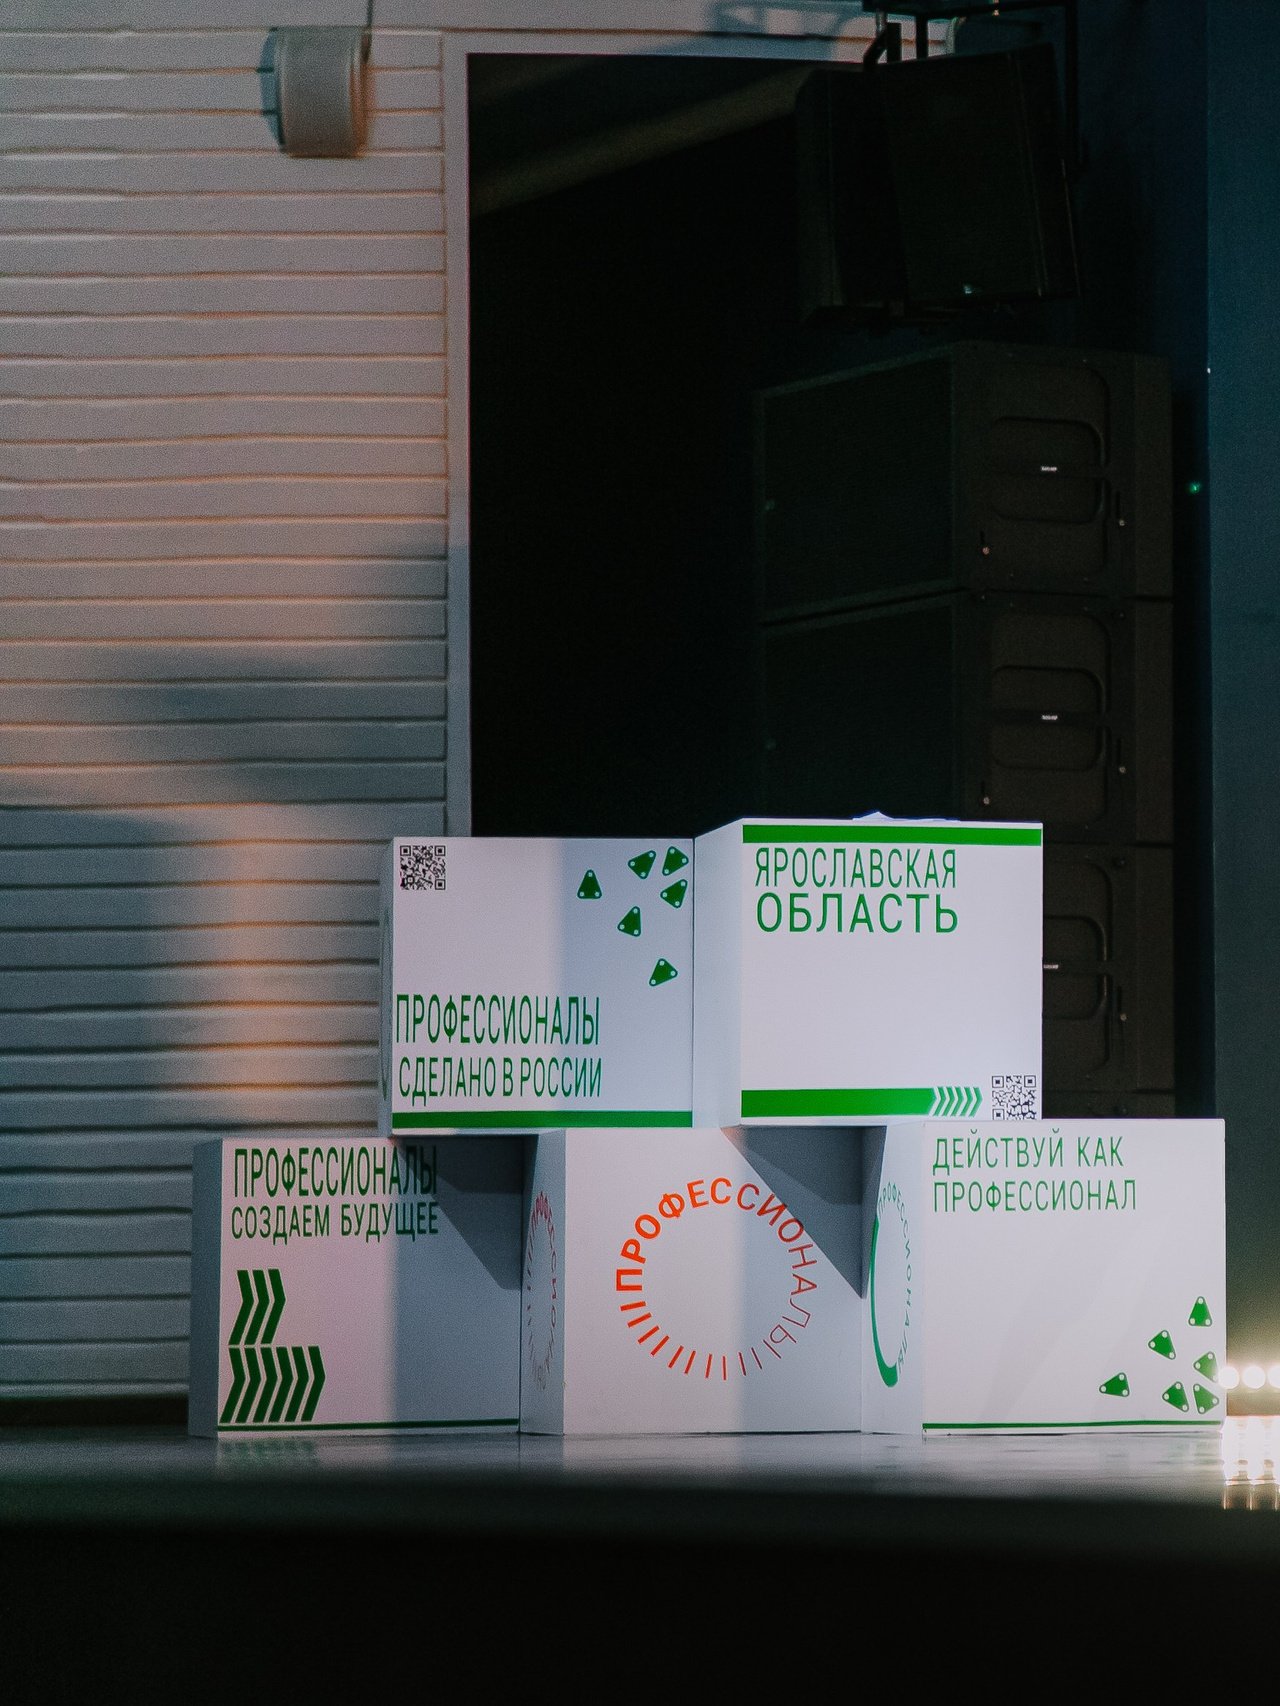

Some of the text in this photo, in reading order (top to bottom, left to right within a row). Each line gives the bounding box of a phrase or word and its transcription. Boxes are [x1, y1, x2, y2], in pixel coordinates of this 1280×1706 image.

[755, 846, 957, 889] ЯРОСЛАВСКАЯ
[756, 891, 959, 934] ОБЛАСТЬ
[395, 993, 600, 1046] ПРОФЕССИОНАЛЫ
[399, 1056, 602, 1105] СДЕЛАНО В РОССИИ
[233, 1145, 438, 1198] ПРОФЕССИОНАЛЫ
[932, 1128, 1125, 1176] ДЕЙСТВУЙ КАК
[933, 1178, 1137, 1213] ПРОФЕССИОНАЛ
[231, 1201, 439, 1246] СОЗДАЕМ БУДУЩЕЕ
[615, 1177, 819, 1361] ПРОФЕССИОНАЛЫ
